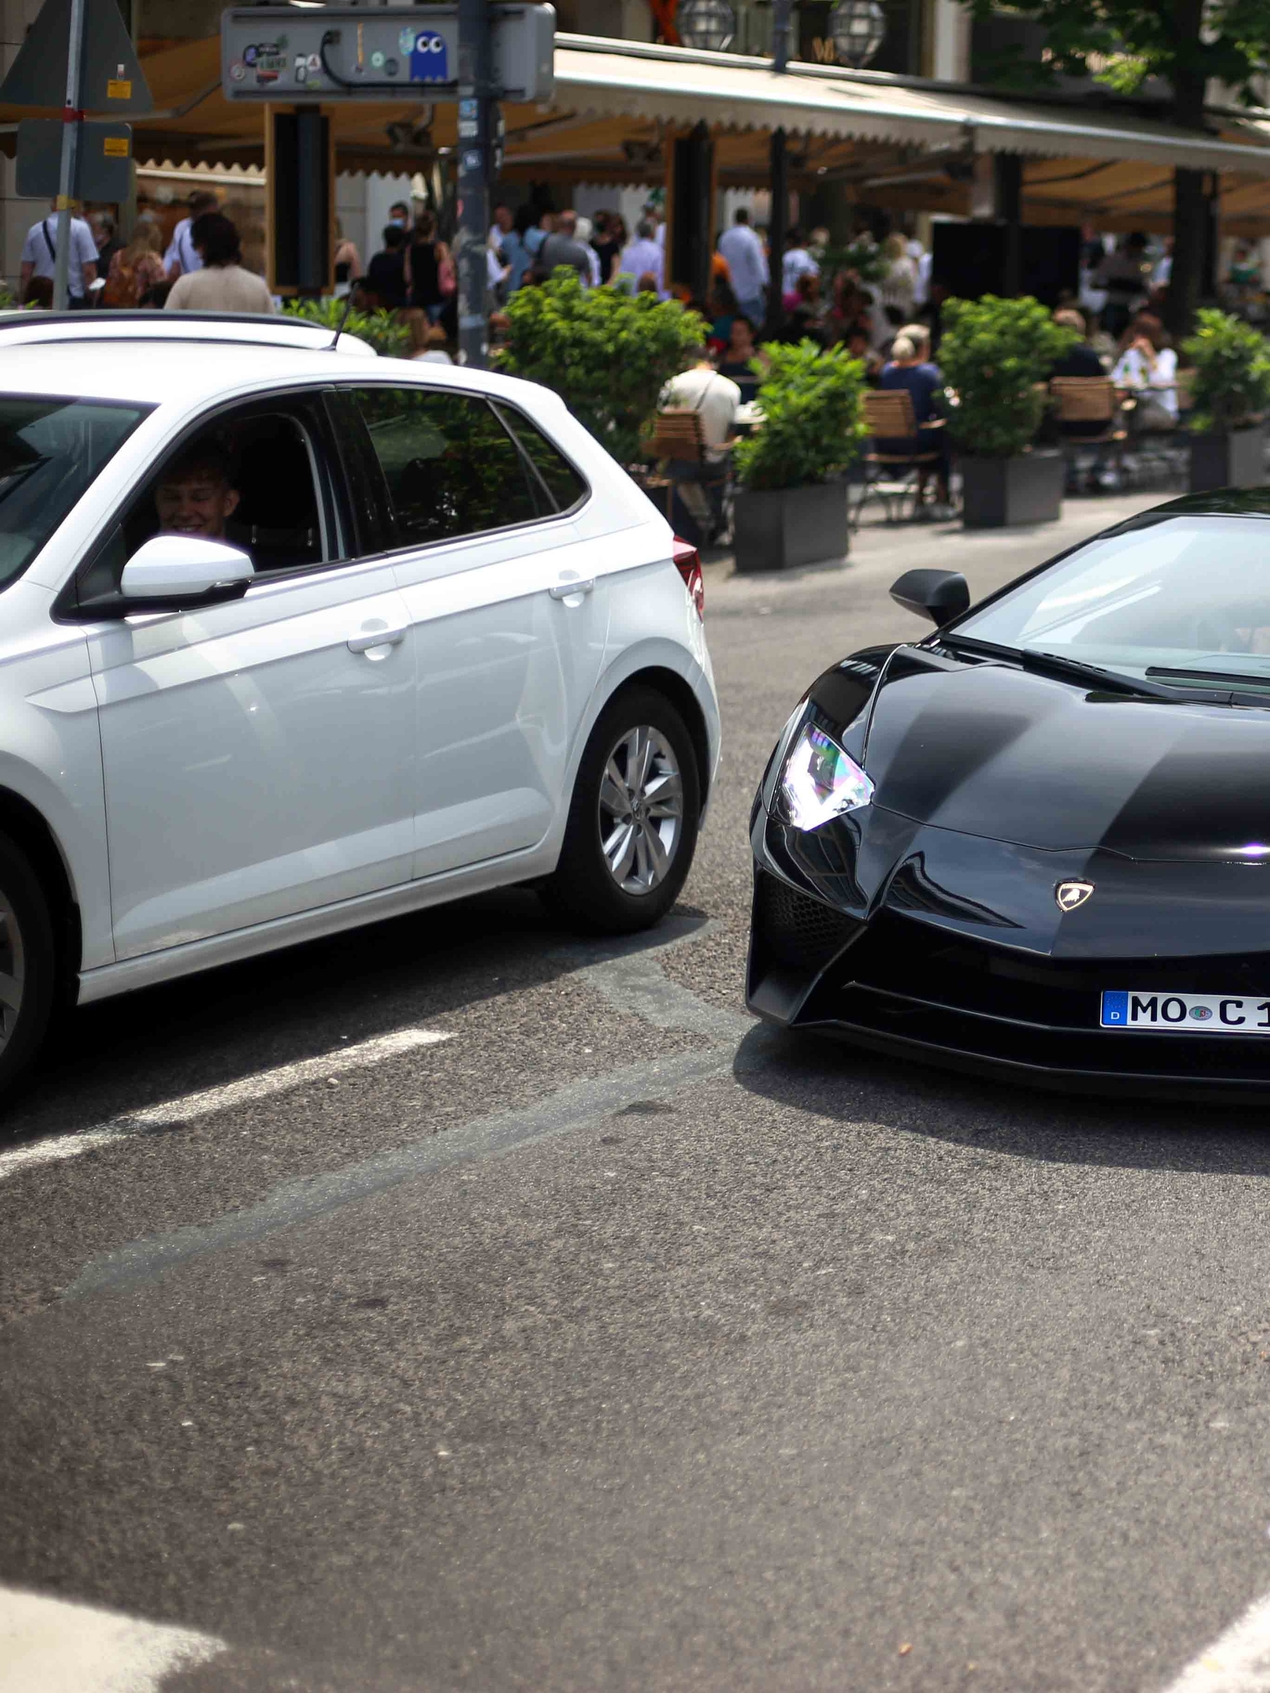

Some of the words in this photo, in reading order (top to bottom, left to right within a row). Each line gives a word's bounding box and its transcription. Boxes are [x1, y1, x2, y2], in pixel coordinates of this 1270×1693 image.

[1110, 1012, 1120, 1020] D
[1131, 996, 1187, 1022] MO
[1219, 1000, 1246, 1025] C
